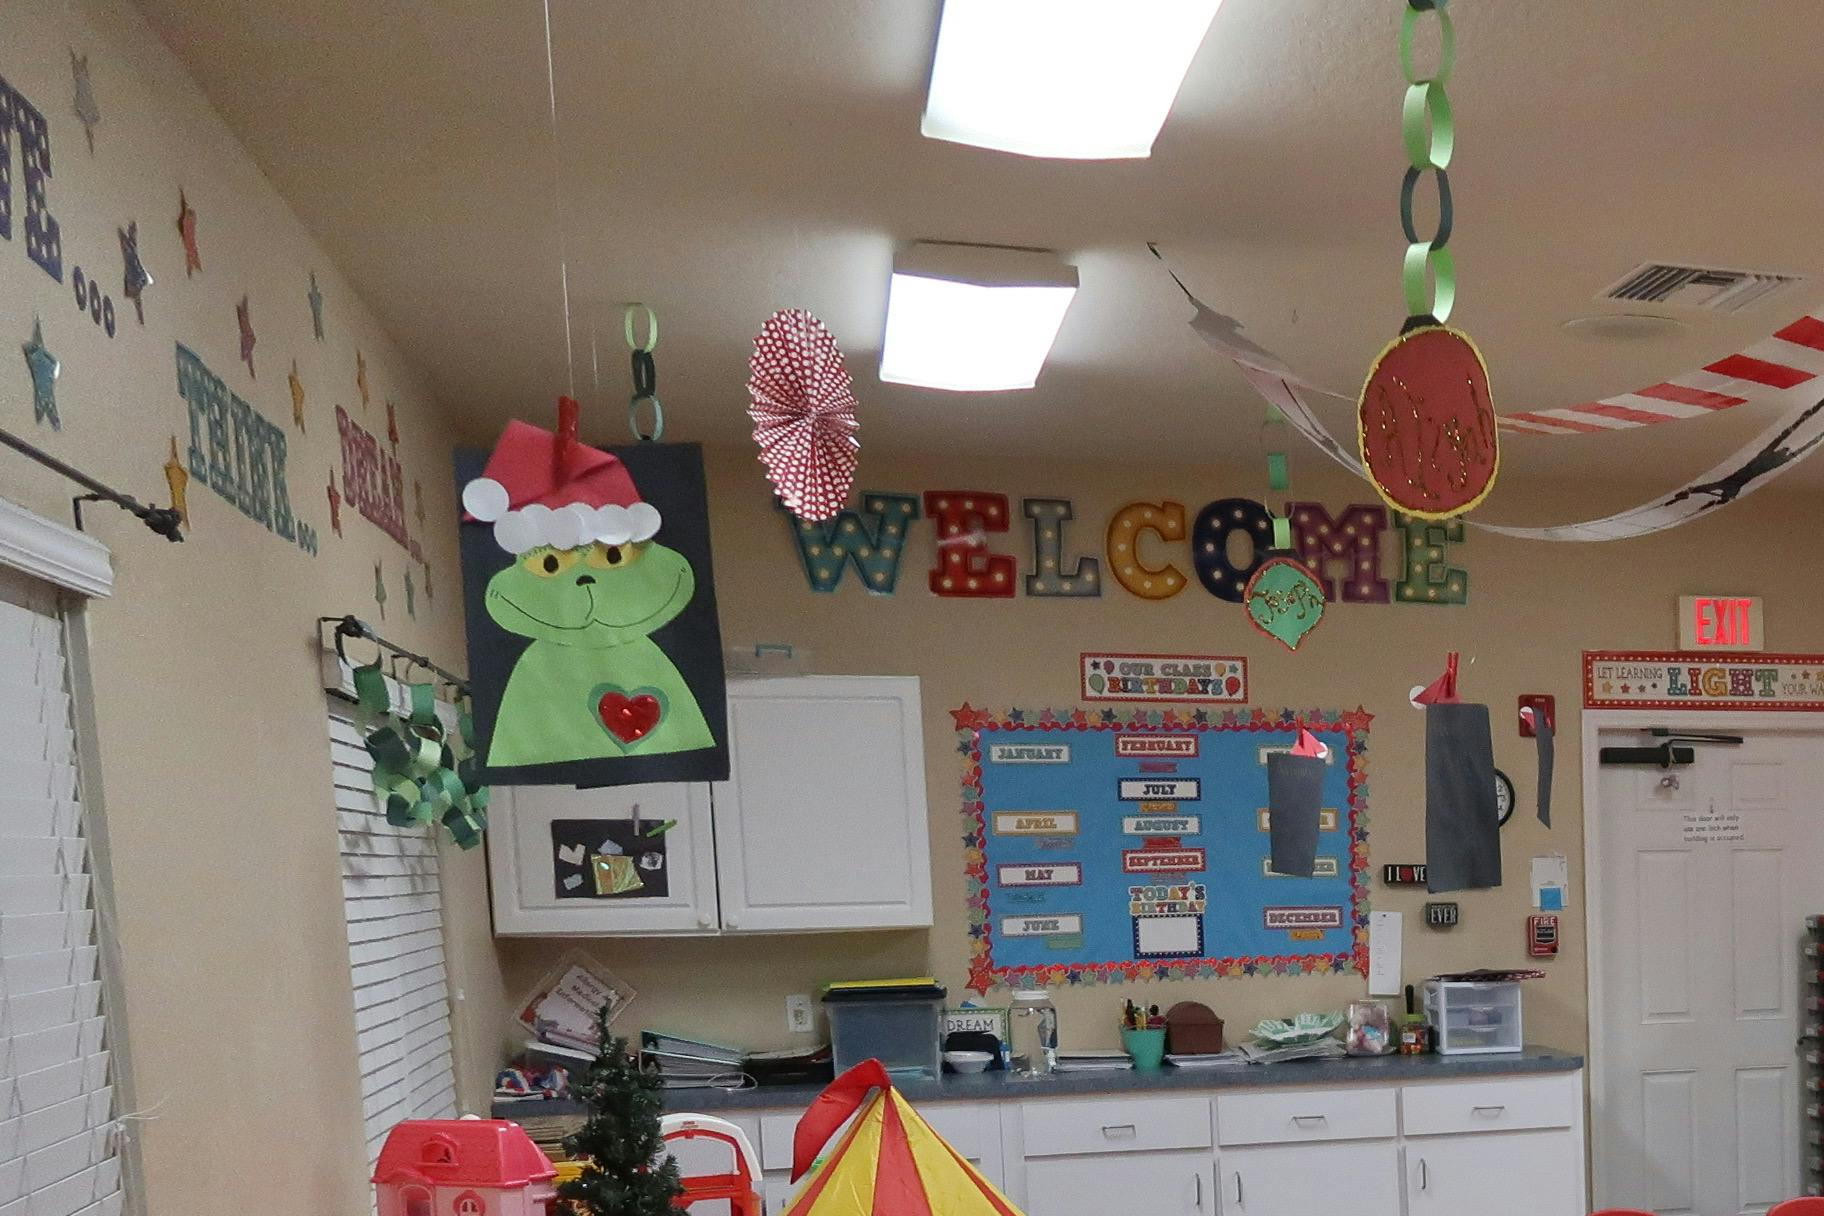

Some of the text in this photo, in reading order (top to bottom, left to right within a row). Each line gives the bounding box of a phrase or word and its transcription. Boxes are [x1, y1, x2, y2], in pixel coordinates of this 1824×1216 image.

[774, 489, 1468, 606] WELCOME
[1695, 598, 1752, 646] EXIT
[1119, 662, 1211, 678] OUR CLASS
[1597, 666, 1663, 681] LET LEARNING
[1107, 676, 1224, 696] BIRTHDAYS
[1667, 667, 1779, 697] LIGHT
[1782, 682, 1808, 696] YOUR
[1121, 740, 1193, 752] FEBRUARY
[998, 748, 1064, 760] JANUARY
[1142, 784, 1177, 796] JULY
[1015, 817, 1057, 830] APRIL
[1134, 820, 1189, 831] AUGUST
[1025, 869, 1054, 881] MAY
[1129, 882, 1206, 901] TODAY'S
[1131, 901, 1205, 914] BIRTHDAY
[1268, 912, 1338, 924] DECEMBER
[1430, 907, 1457, 924] EVER
[1534, 916, 1556, 926] FIRE
[1022, 919, 1060, 932] JUNE
[946, 1018, 994, 1032] DREAM
